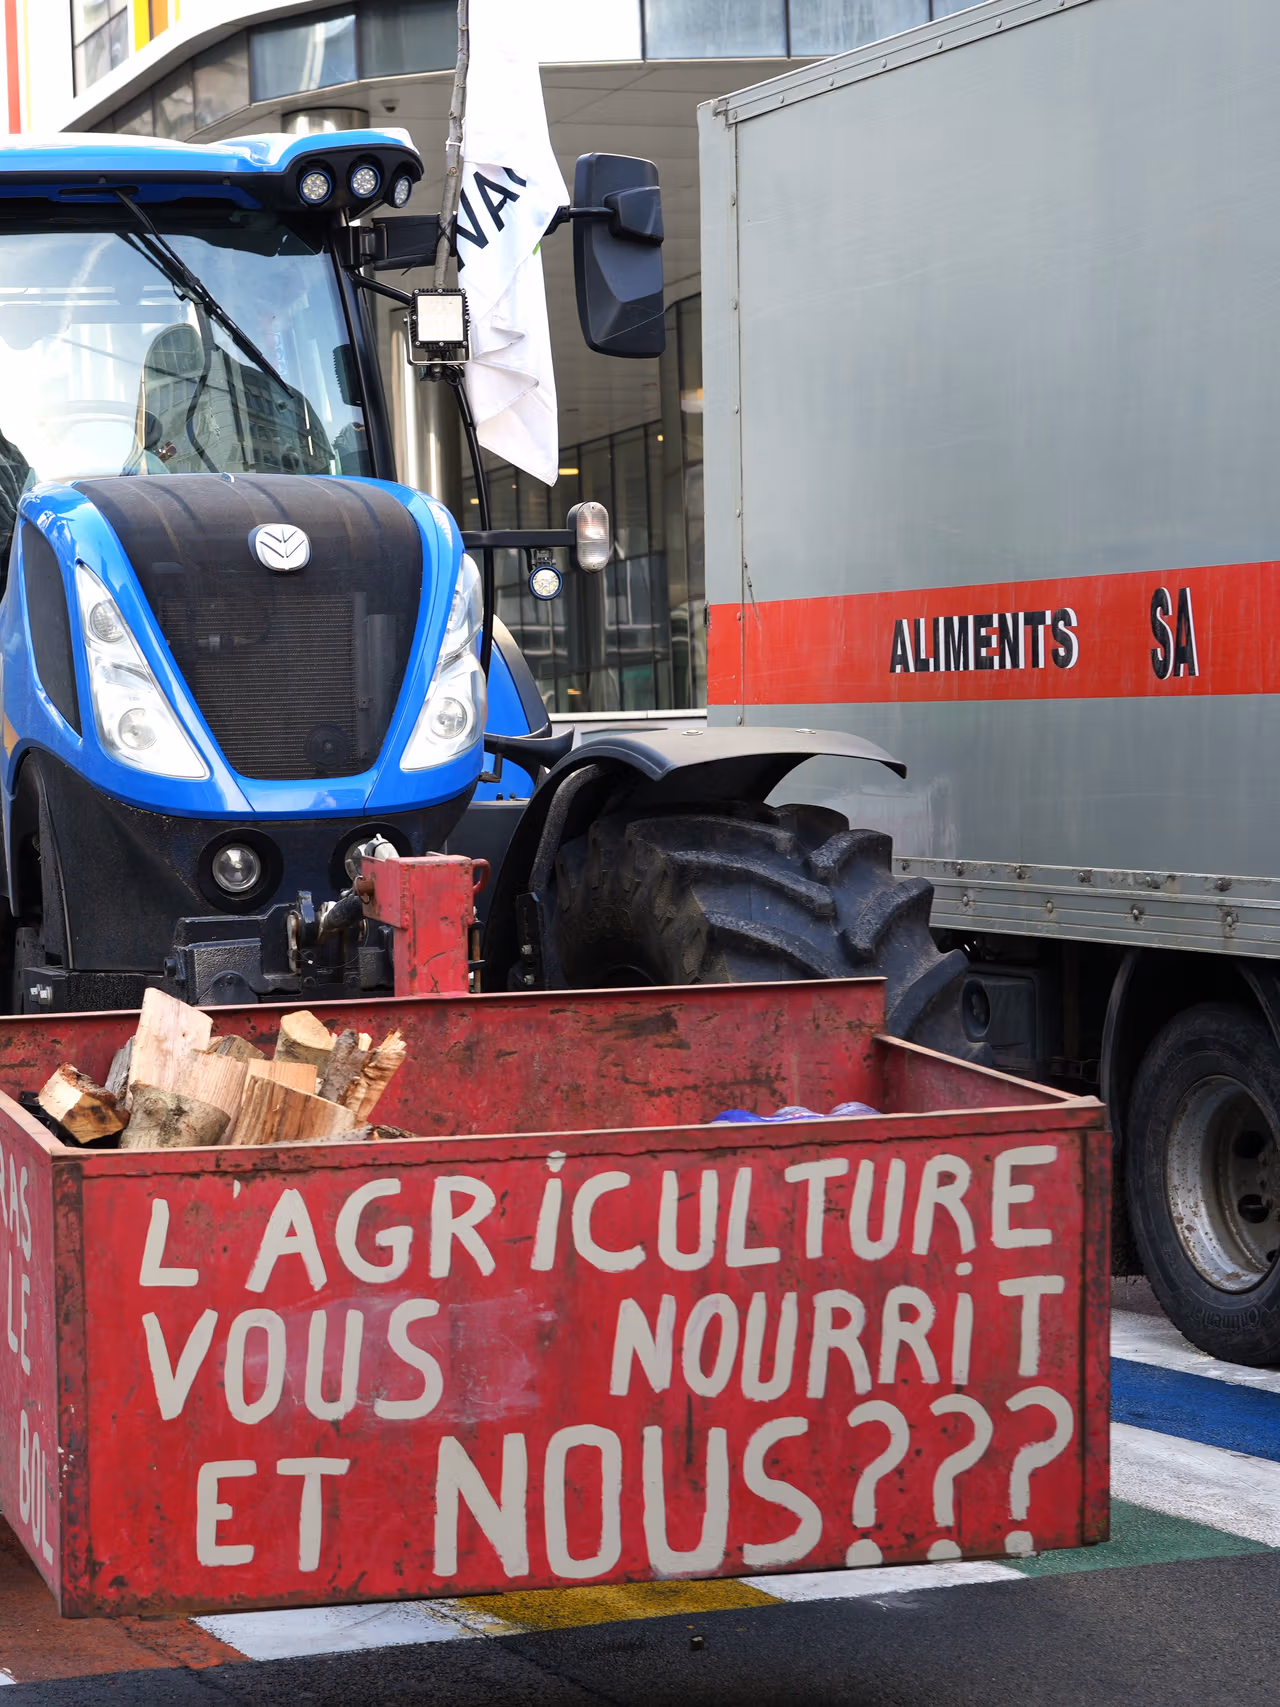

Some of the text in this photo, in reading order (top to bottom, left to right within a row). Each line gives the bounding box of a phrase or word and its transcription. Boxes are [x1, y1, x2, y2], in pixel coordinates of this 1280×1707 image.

[889, 586, 1200, 681] ALIMENTS SA
[7, 1252, 32, 1377] LE
[141, 1261, 1066, 1426] VOUS NOURRIT
[19, 1408, 55, 1567] BOL
[195, 1385, 1075, 1580] ET NOUS???
